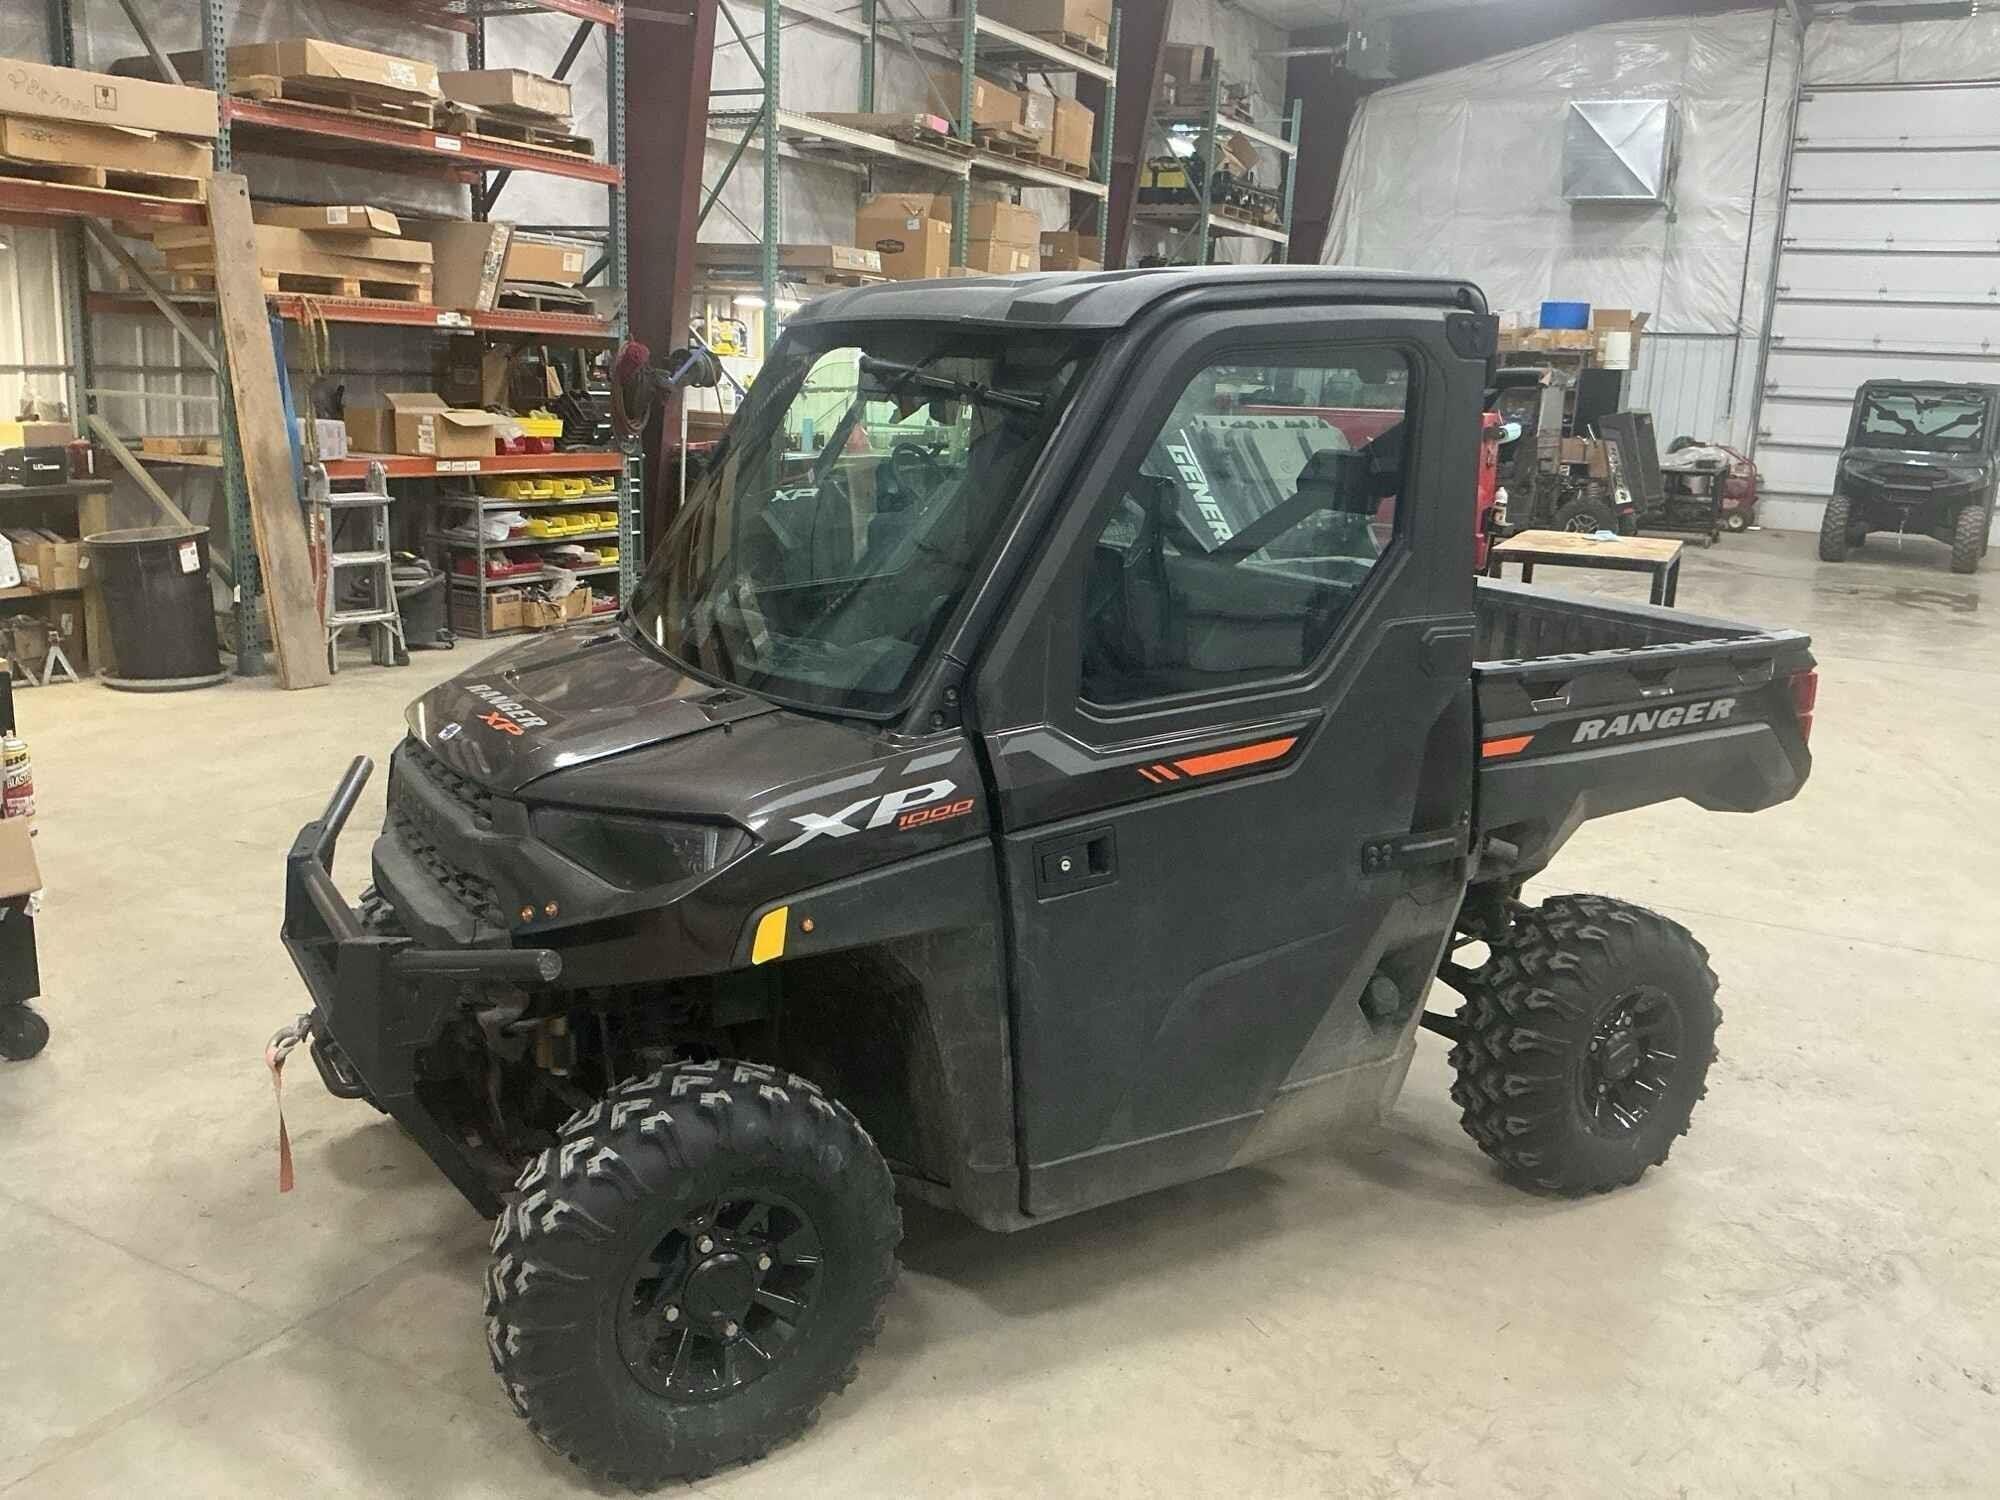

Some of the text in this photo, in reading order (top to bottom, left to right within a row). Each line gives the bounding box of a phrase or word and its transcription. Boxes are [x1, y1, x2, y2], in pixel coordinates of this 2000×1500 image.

[771, 488, 820, 502] XP
[1166, 444, 1234, 546] GENER
[464, 684, 548, 728] RANGER
[476, 711, 525, 736] XP
[1571, 698, 1736, 744] RANGER
[768, 778, 957, 856] XP
[898, 799, 975, 827] 1000
